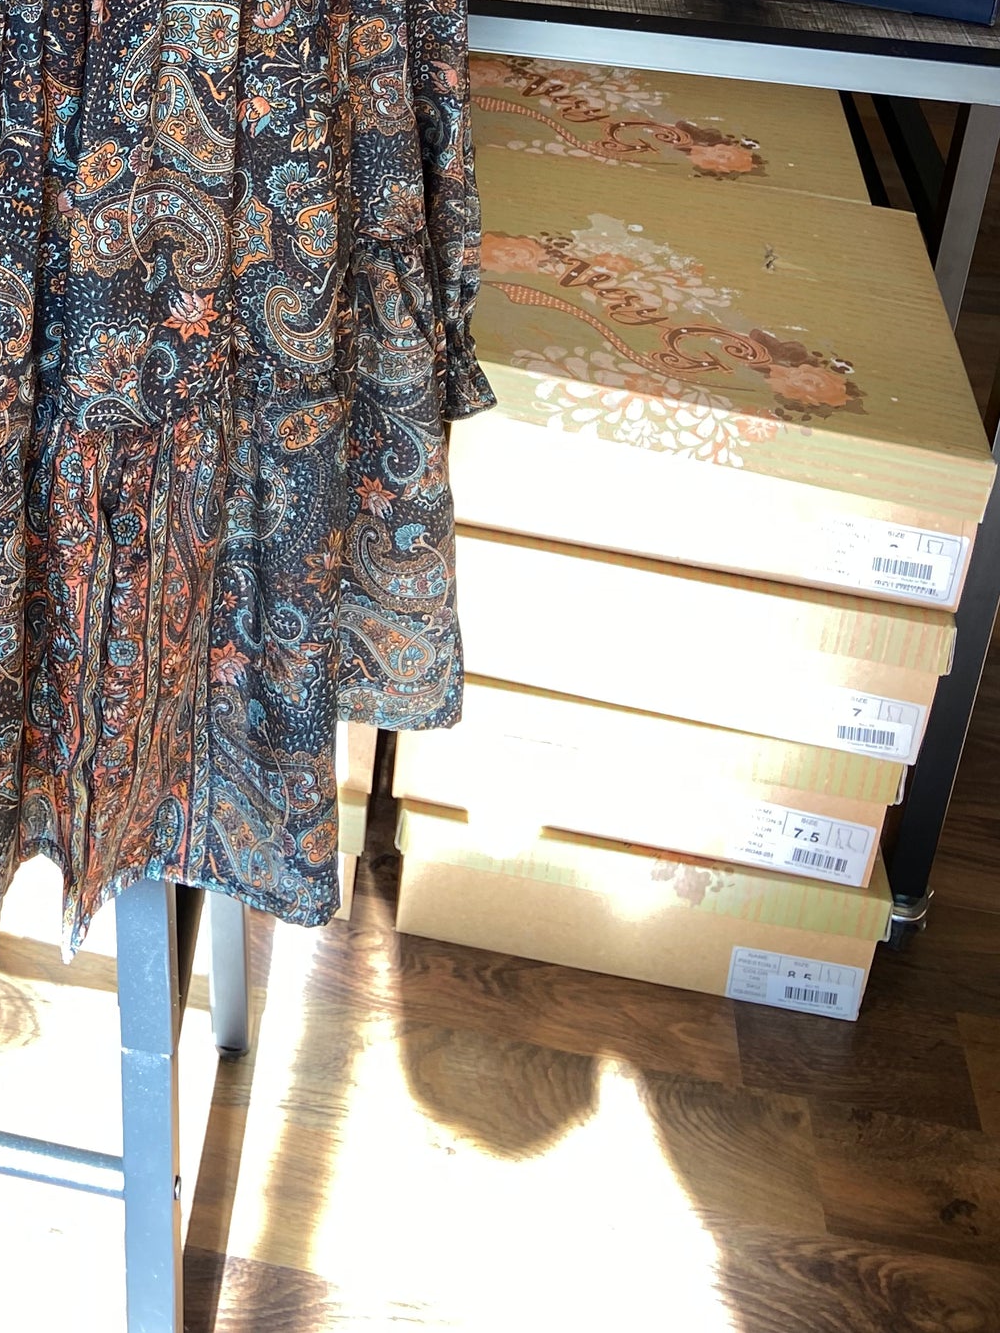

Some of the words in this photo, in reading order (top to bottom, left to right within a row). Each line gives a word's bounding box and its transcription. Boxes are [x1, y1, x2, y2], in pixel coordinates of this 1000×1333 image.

[887, 530, 906, 539] SIZE
[853, 708, 862, 717] 7
[793, 827, 820, 843] 7.5
